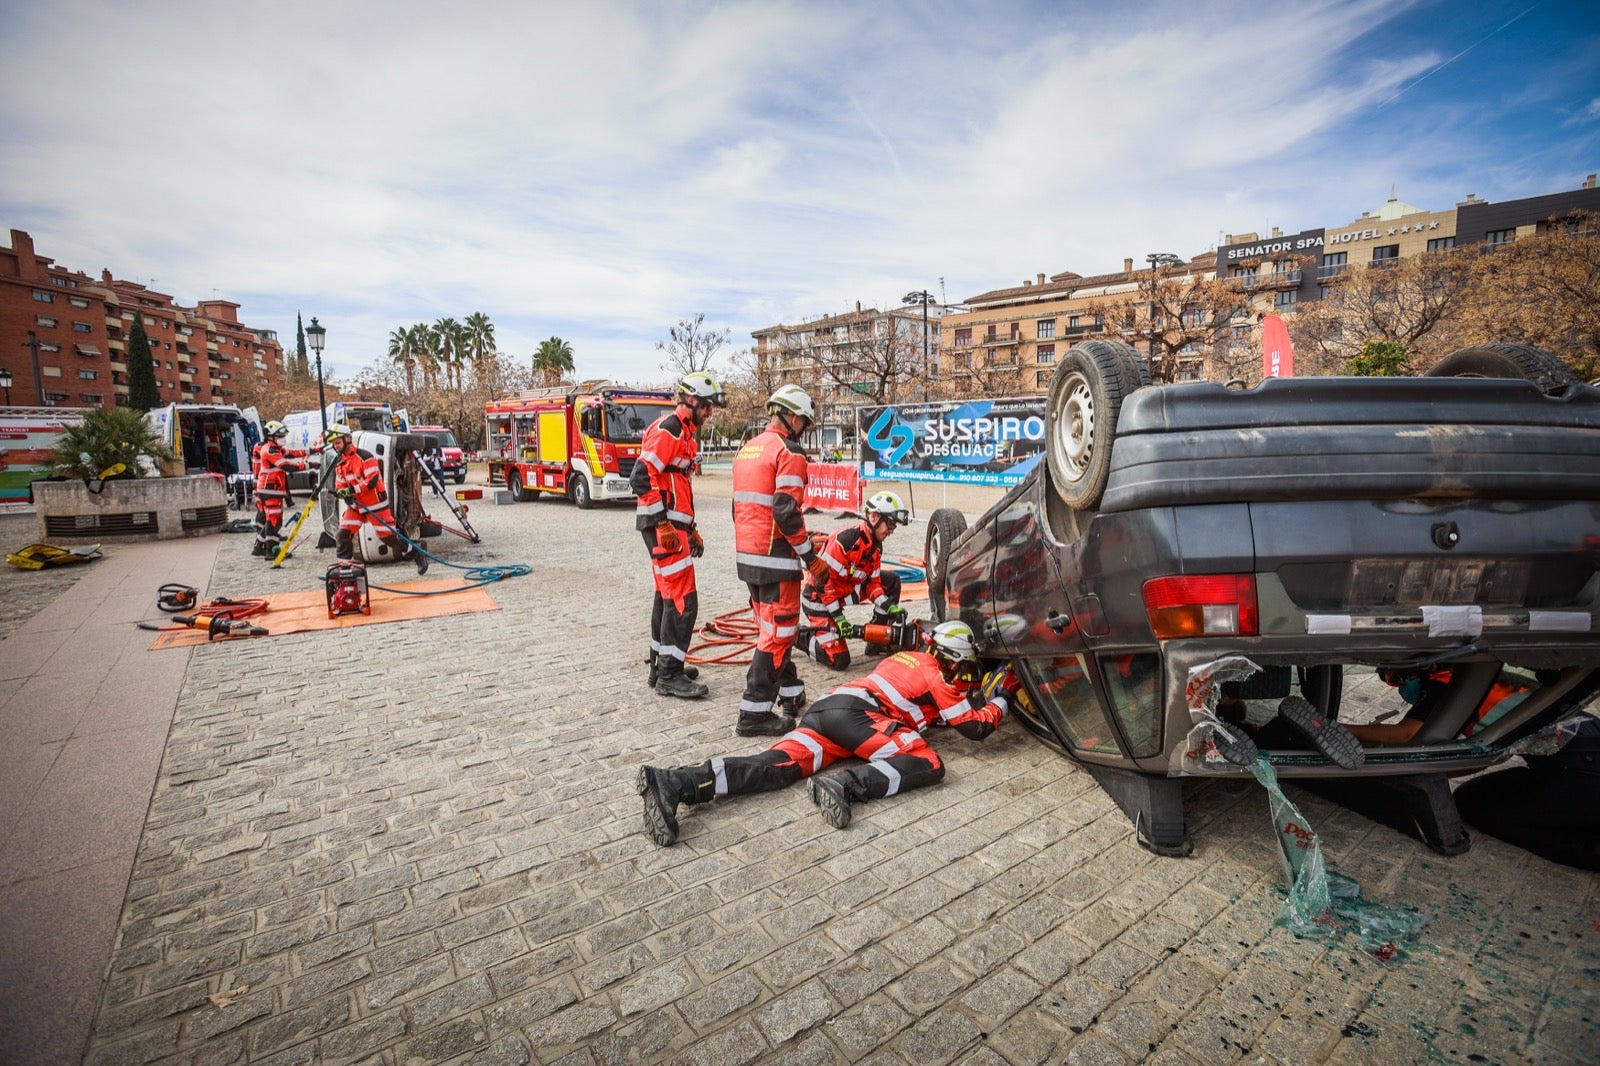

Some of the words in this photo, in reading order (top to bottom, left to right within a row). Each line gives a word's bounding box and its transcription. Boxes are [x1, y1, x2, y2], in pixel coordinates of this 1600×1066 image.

[1228, 241, 1291, 259] SENATOR
[1296, 236, 1325, 250] SPA
[1329, 228, 1382, 245] HOTEL
[924, 416, 1045, 441] SUSPIRO
[924, 443, 1004, 458] DESGUACE
